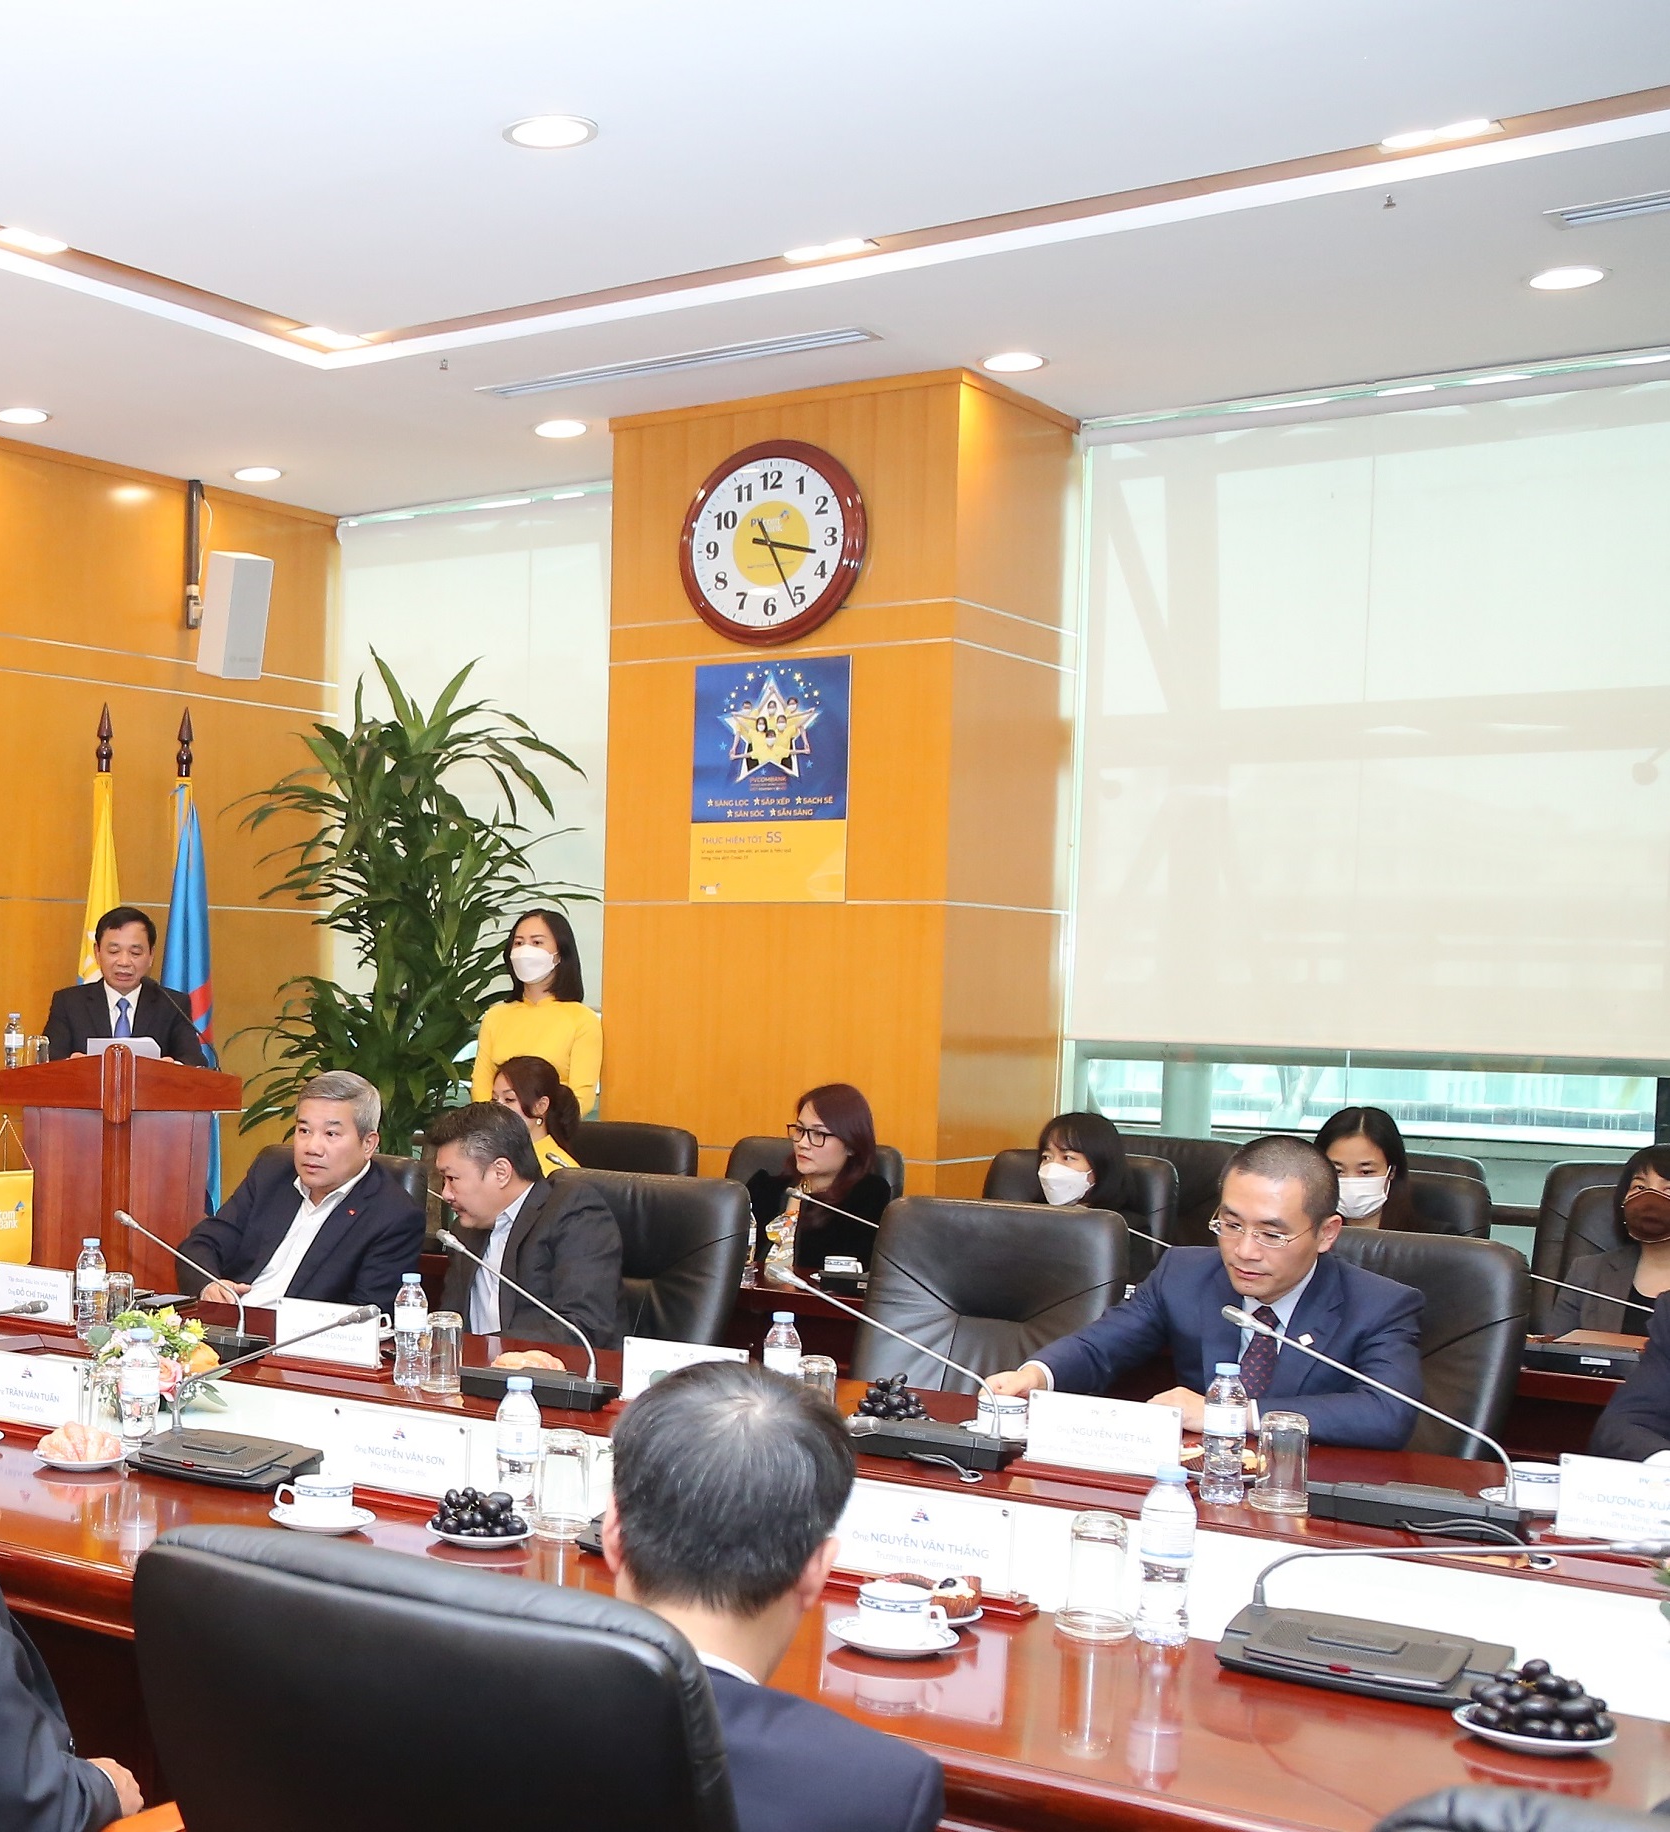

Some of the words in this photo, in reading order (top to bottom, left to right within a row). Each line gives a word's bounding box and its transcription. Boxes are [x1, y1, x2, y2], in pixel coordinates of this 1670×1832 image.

[760, 470, 783, 491] 12
[796, 476, 805, 495] 1
[734, 483, 753, 503] 11
[814, 495, 829, 515] 2
[714, 510, 738, 531] 10
[824, 526, 838, 546] 3
[706, 541, 720, 560] 9
[814, 560, 827, 579] 4
[714, 571, 728, 590] 8
[736, 592, 748, 610] 7
[793, 585, 806, 605] 5
[763, 597, 777, 617] 6
[766, 831, 782, 844] 5S
[5, 1386, 24, 1398] TRẦN
[25, 1389, 40, 1400] VĂN
[41, 1391, 59, 1403] TUẤN
[1071, 1424, 1113, 1440] NGUYỄN
[1114, 1431, 1135, 1443] VIỆT
[367, 1445, 404, 1460] NGUYỄN
[405, 1450, 424, 1463] VĂN
[425, 1455, 445, 1466] SƠN
[1596, 1493, 1646, 1509] DƯƠNG
[852, 1529, 869, 1543] Ông
[870, 1531, 918, 1549] NGUYỄN
[920, 1537, 944, 1552] VĂN
[947, 1538, 990, 1560] THẮNG
[905, 1554, 921, 1565] Ban
